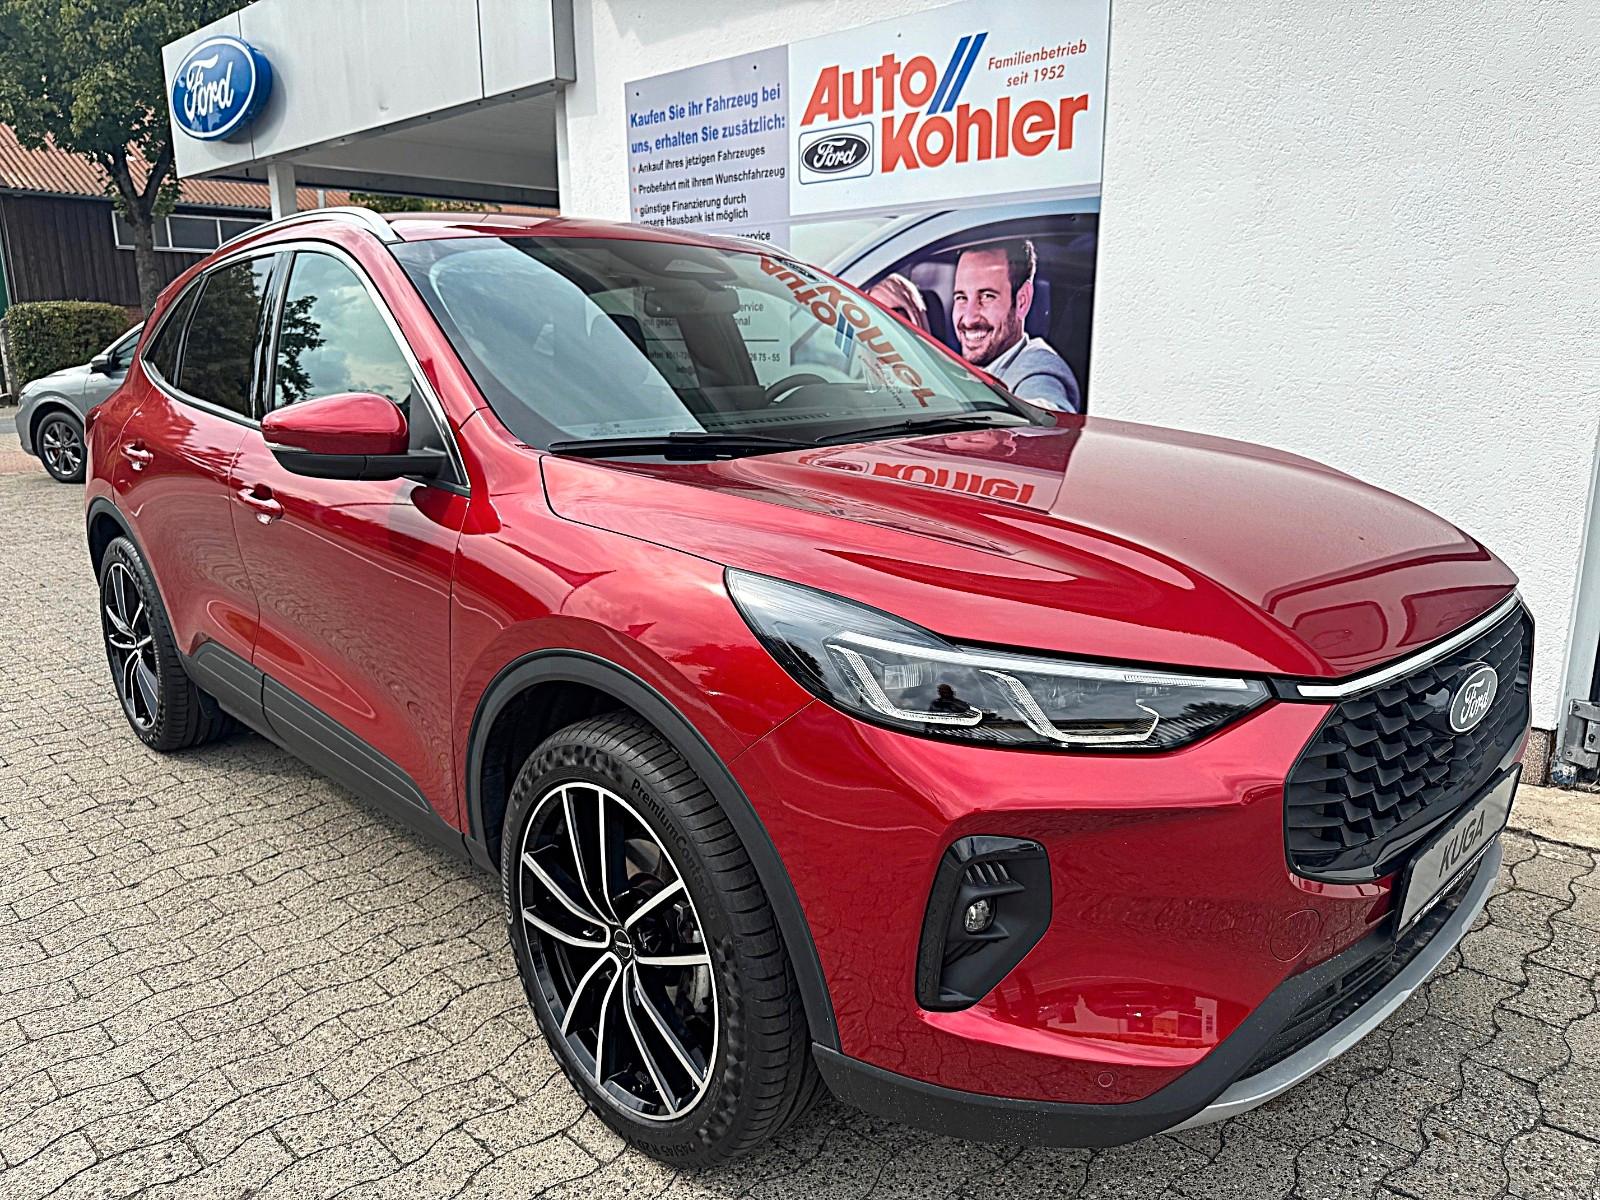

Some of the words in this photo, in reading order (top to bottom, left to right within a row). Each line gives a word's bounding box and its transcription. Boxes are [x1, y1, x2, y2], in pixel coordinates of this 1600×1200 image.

[988, 40, 1087, 71] Familienbetrieb
[184, 54, 234, 122] Ford
[800, 53, 937, 126] Auto
[1006, 73, 1029, 87] seit
[1033, 65, 1065, 84] 1952
[630, 109, 666, 128] Kaufen
[669, 104, 685, 120] Sie
[688, 100, 703, 117] ihr
[706, 91, 758, 113] Fahrzeug
[762, 83, 781, 100] bei
[631, 141, 653, 155] uns,
[655, 130, 698, 150] erhalten
[701, 126, 719, 142] Sie
[722, 114, 785, 139] zusätzlich:
[881, 94, 1089, 173] Kohler
[638, 159, 664, 174] Ankauf
[665, 158, 684, 170] ihres
[685, 153, 716, 170] jetzigen
[717, 145, 766, 162] Fahrzeuges
[813, 138, 856, 170] Ford
[638, 179, 677, 195] Probefahrt
[678, 178, 691, 191] mit
[692, 175, 714, 189] ihrem
[715, 166, 785, 184] Wunschfahrzeug
[639, 201, 671, 217] günstige
[672, 196, 722, 212] Finanzierung
[722, 193, 747, 206] durch
[666, 210, 703, 226] Hausbank
[704, 208, 714, 222] ist
[716, 208, 749, 224] möglich
[1460, 677, 1491, 724] Ford
[1439, 809, 1485, 878] KUGA
